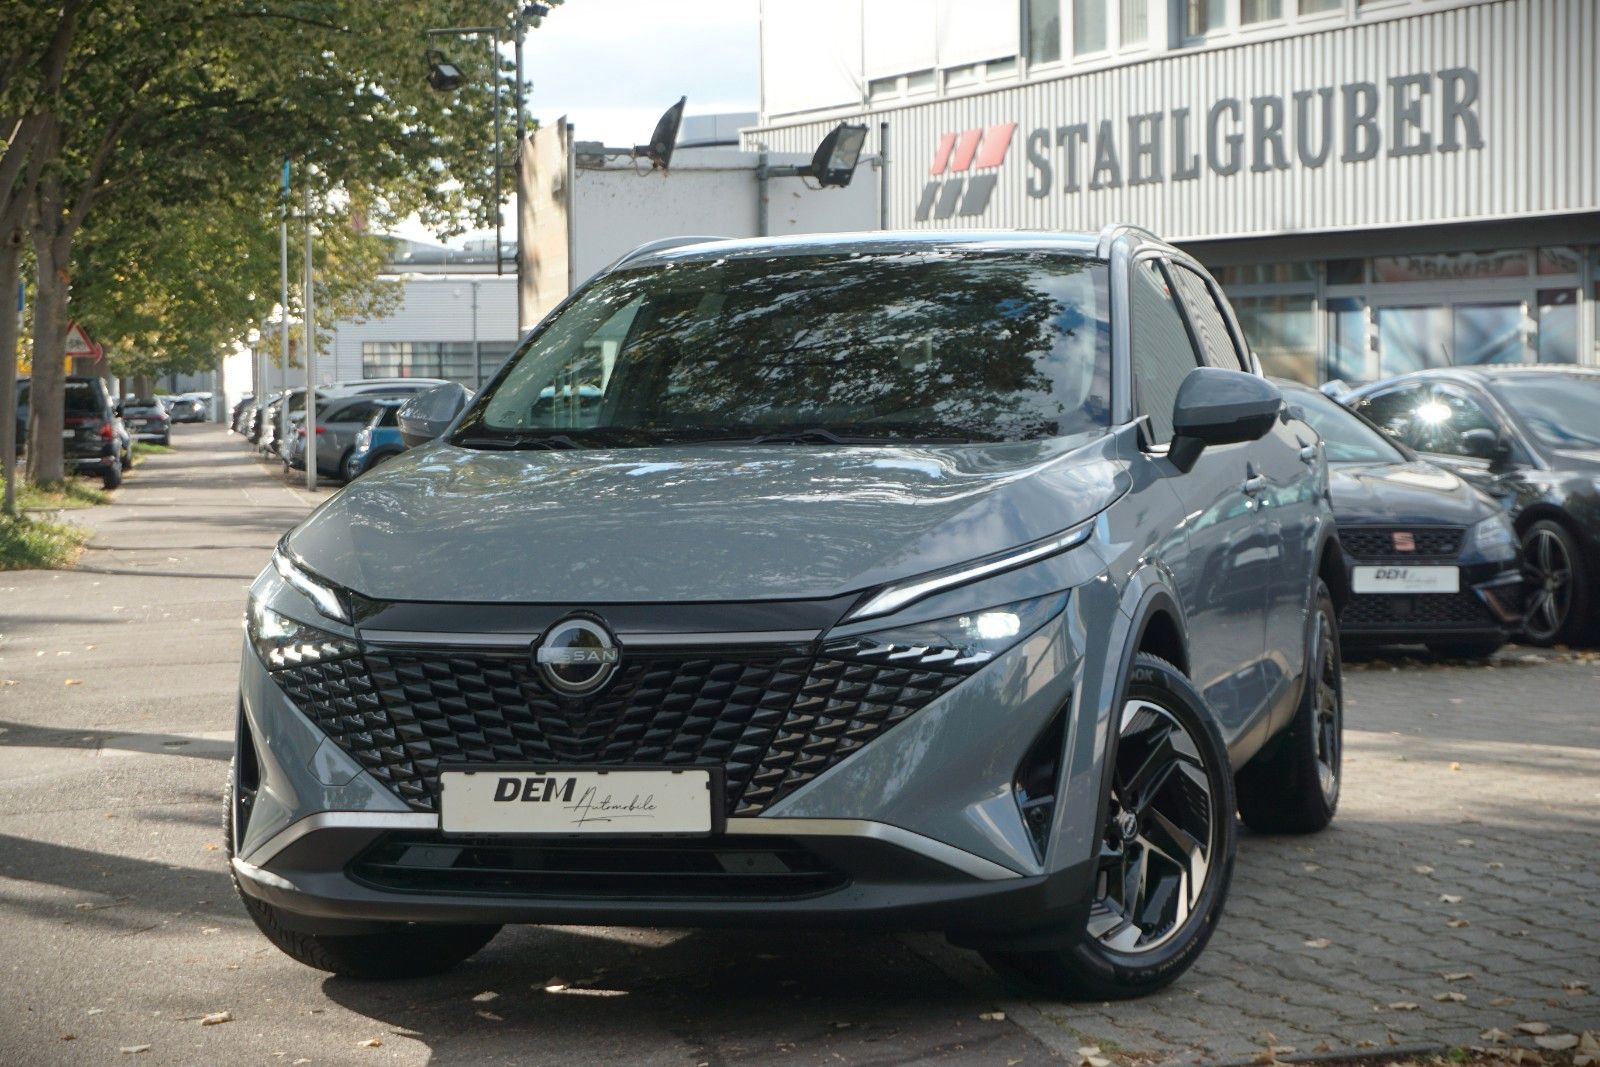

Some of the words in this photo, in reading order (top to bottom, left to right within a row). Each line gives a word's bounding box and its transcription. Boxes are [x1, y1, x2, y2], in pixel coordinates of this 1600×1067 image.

[1026, 66, 1485, 199] STAHLGRUBER
[493, 777, 577, 802] DEM
[564, 785, 657, 827] Automobile
